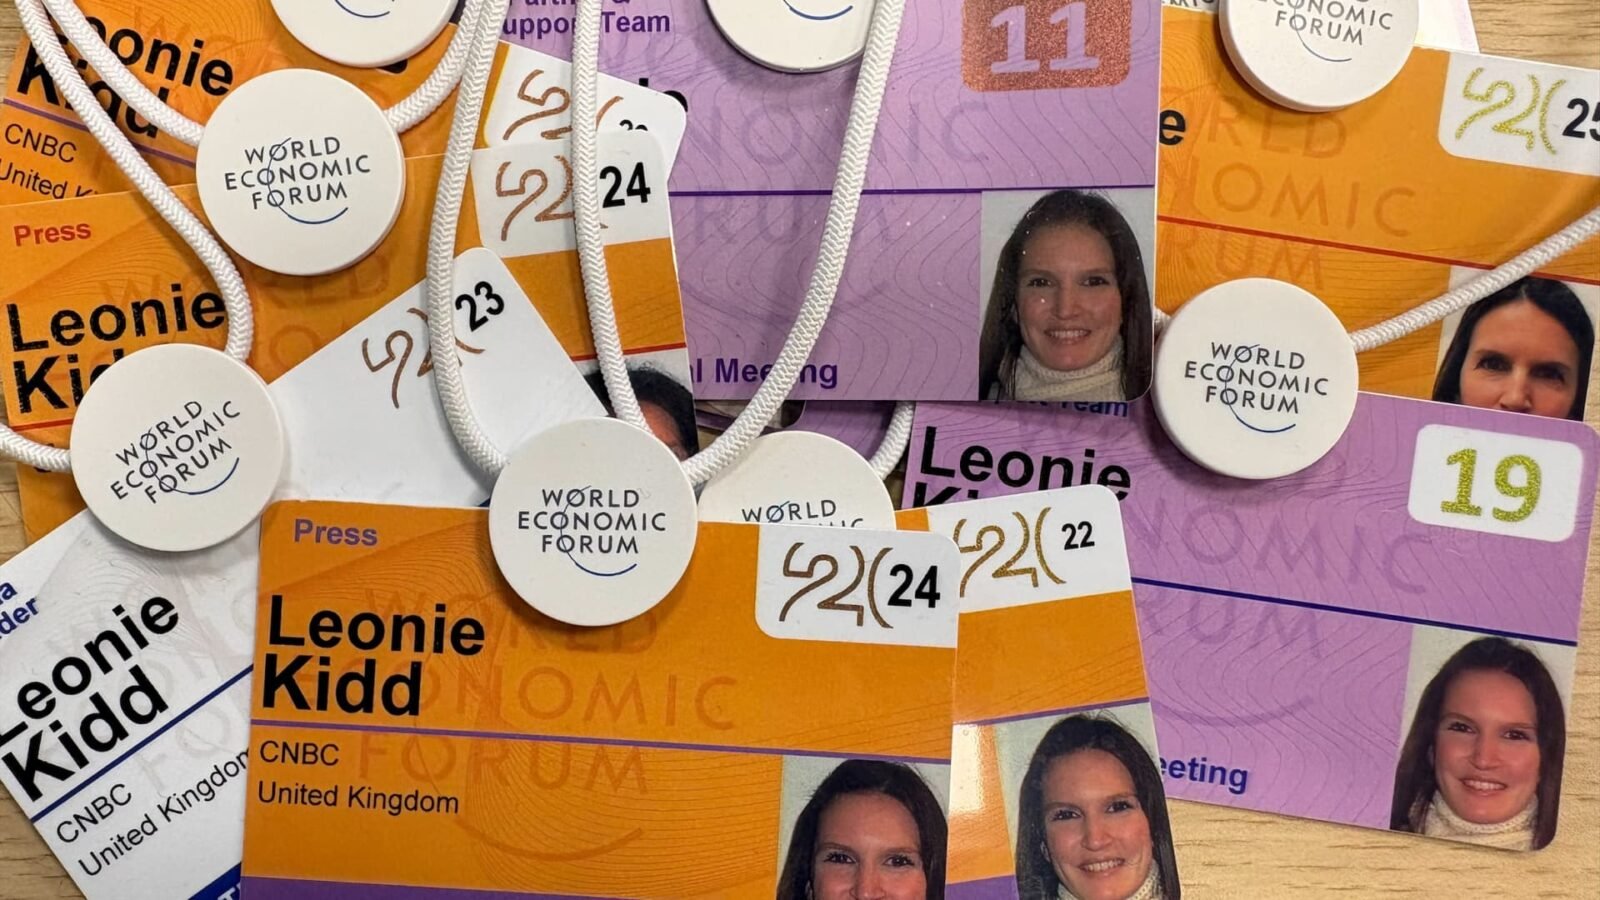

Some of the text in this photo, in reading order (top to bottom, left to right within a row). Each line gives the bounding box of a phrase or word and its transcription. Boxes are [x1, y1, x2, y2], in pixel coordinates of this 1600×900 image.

[601, 11, 670, 32] Team
[990, 3, 1100, 73] 11
[1275, 10, 1363, 45] FORUM
[5, 123, 77, 163] CNBC
[245, 137, 340, 165] WORLD
[0, 161, 68, 200] United
[225, 155, 370, 190] ECONOMIC
[599, 162, 651, 208] 24
[252, 182, 347, 210] FORUM
[14, 223, 91, 246] Press
[7, 284, 226, 352] Leonie
[455, 281, 504, 332] 23
[1211, 342, 1305, 369] WORLD
[1185, 361, 1328, 396] ECONOMIC
[1205, 385, 1298, 414] FORUM
[110, 401, 240, 499] ECONOMIC
[116, 401, 202, 466] WORLD
[144, 438, 232, 504] FORUM
[920, 426, 1130, 501] Leonie
[542, 489, 639, 508] WORLD
[1440, 447, 1542, 523] 19
[519, 511, 666, 531] ECONOMIC
[741, 500, 836, 523] WORLD
[294, 518, 378, 546] Press
[542, 535, 639, 554] FORUM
[1061, 521, 1095, 550] 22
[887, 564, 940, 608] 24
[269, 594, 485, 656] Leonie
[263, 653, 422, 716] Kidd
[1, 664, 169, 802] Kidd
[260, 740, 340, 766] CNBC
[56, 784, 132, 843] CNBC
[258, 780, 459, 816] United Kingdom
[78, 814, 158, 876] United
